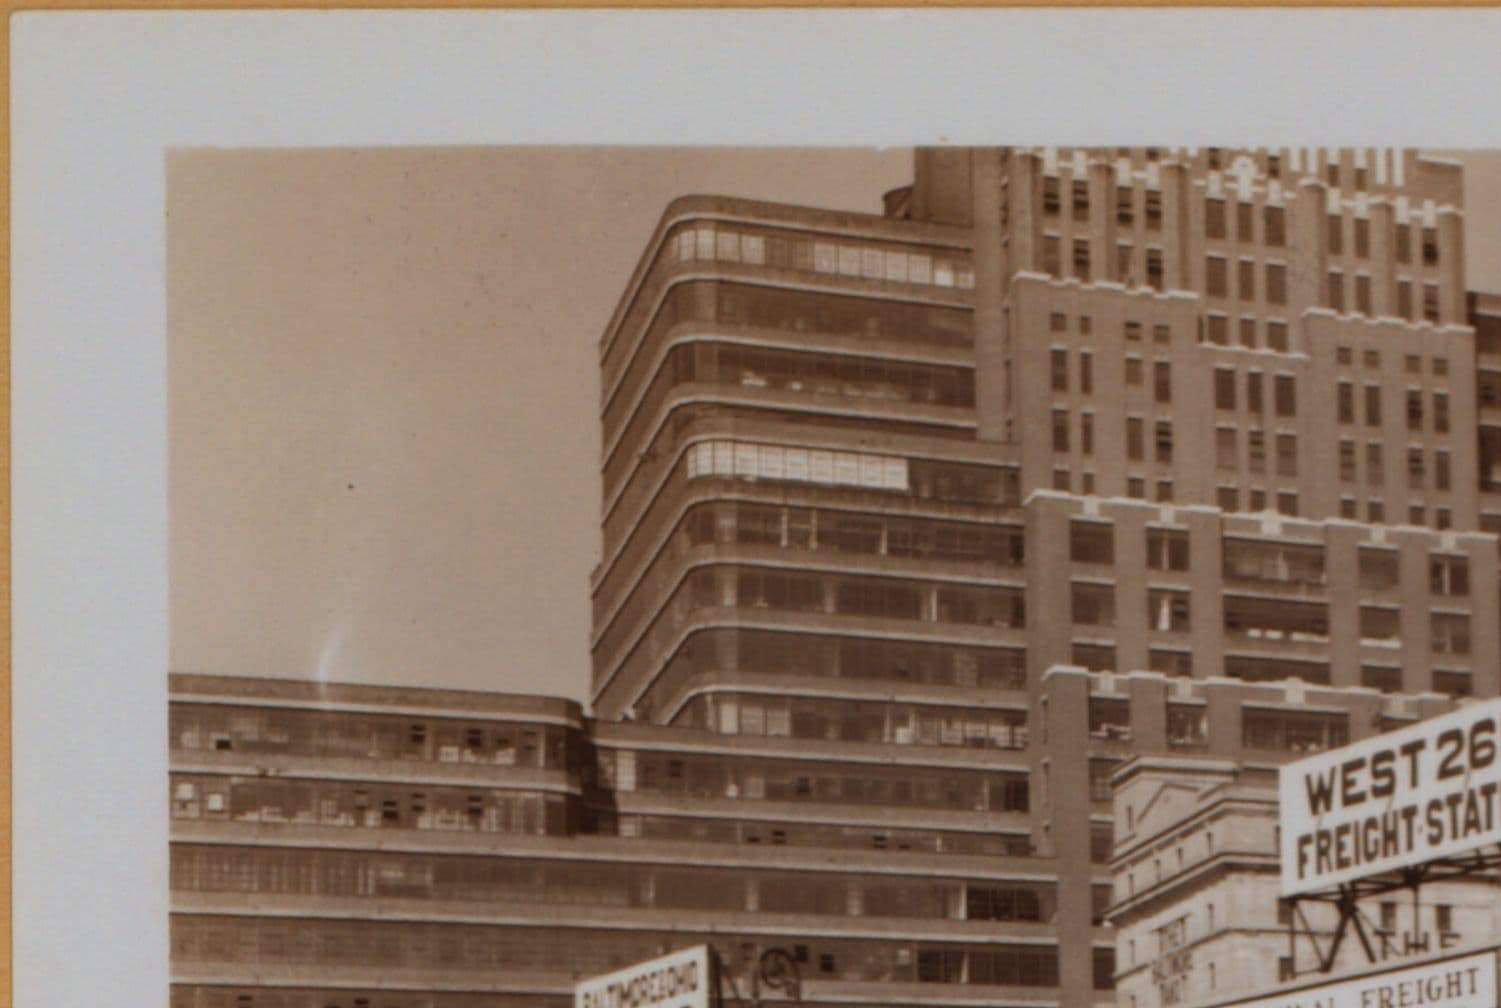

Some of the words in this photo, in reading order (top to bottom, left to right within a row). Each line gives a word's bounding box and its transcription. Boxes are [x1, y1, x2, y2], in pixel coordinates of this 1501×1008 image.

[1305, 738, 1426, 816] WEST
[1436, 717, 1496, 781] 26
[1297, 804, 1418, 880] FREIGHT
